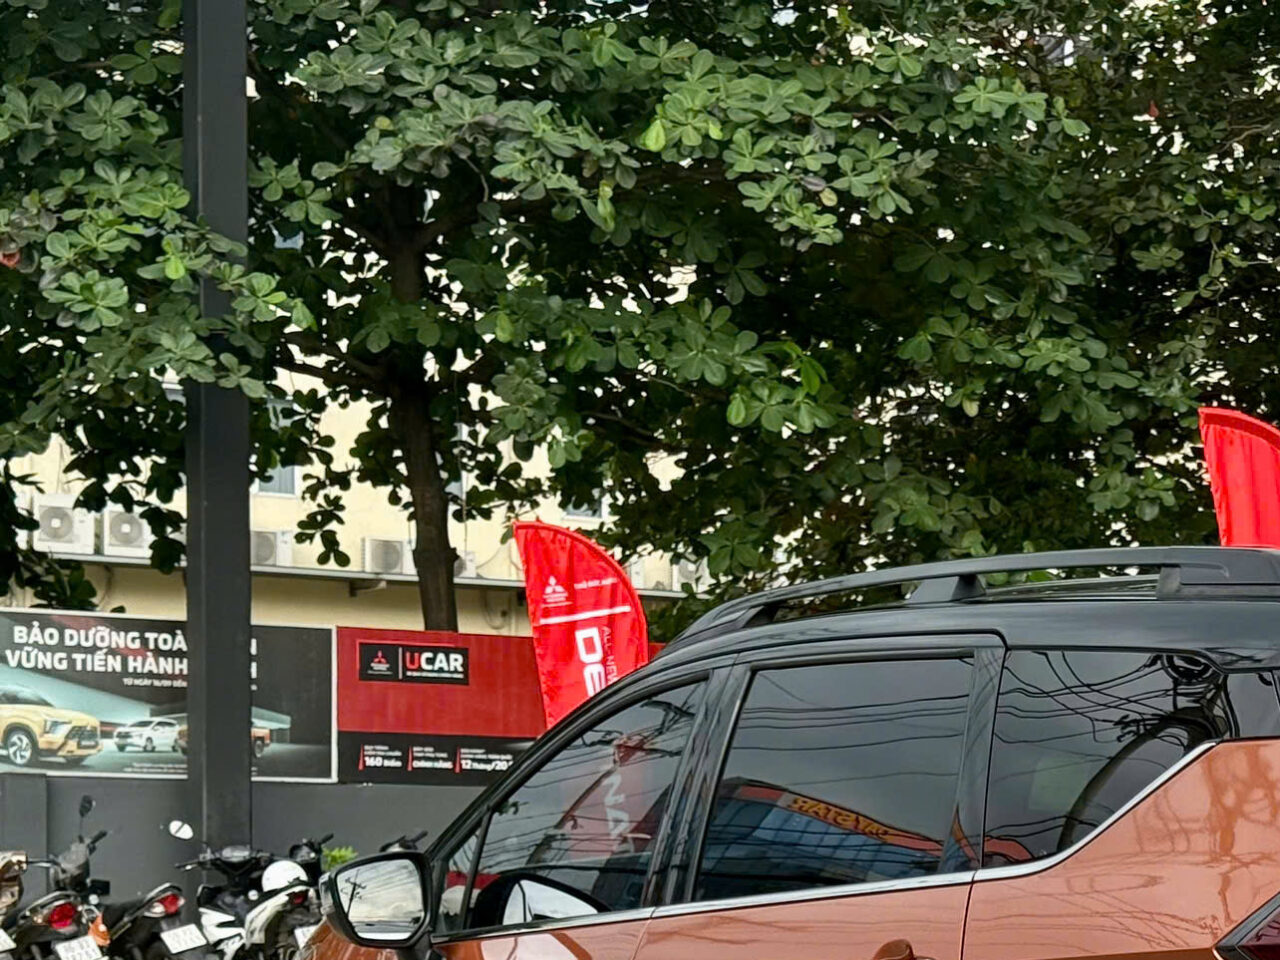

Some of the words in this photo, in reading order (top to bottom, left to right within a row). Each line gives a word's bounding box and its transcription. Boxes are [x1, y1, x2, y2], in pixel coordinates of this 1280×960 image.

[13, 621, 59, 646] BẢO
[64, 625, 140, 649] DƯỠNG
[5, 647, 68, 670] VỮNG
[72, 648, 122, 672] TIẾN
[128, 652, 188, 675] HÀNH
[405, 651, 464, 672] UCAR
